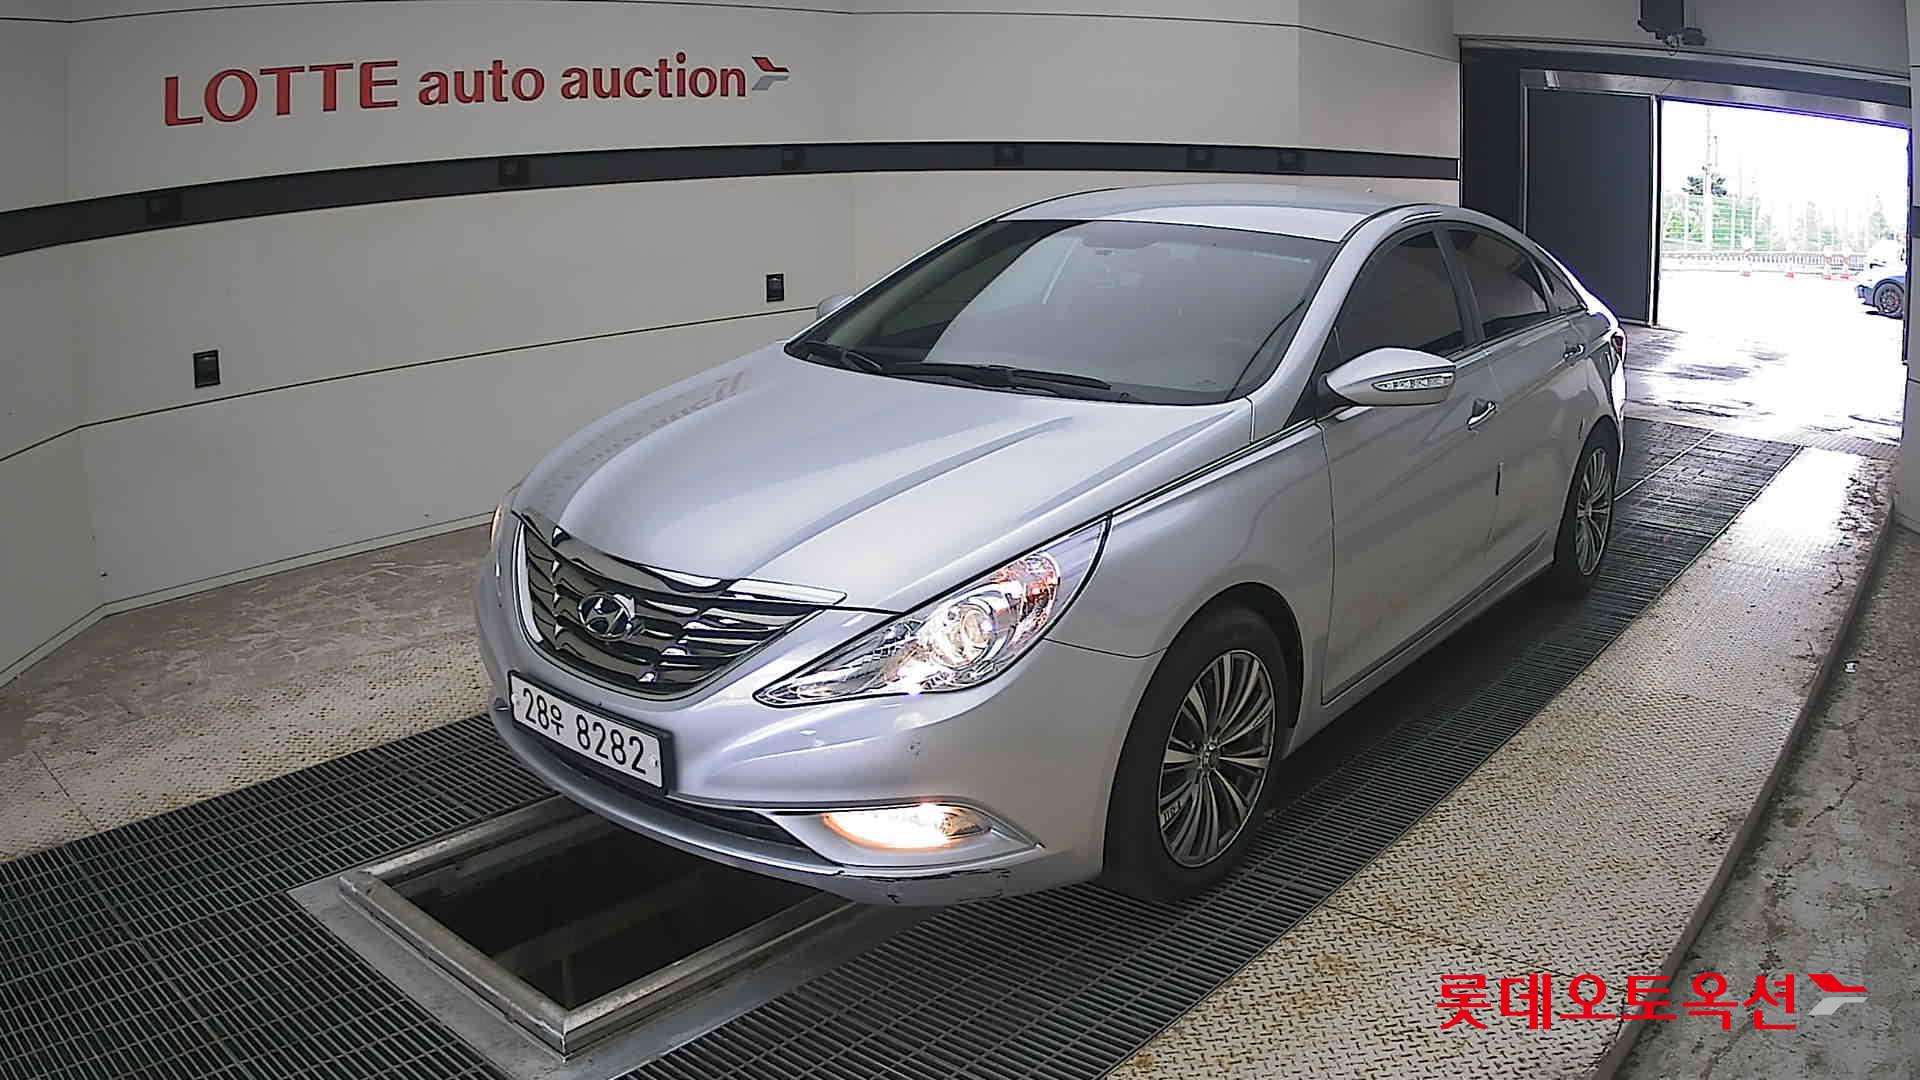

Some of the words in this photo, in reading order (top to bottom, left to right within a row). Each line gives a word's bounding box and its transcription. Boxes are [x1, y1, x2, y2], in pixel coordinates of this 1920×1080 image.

[164, 60, 398, 126] LOTTE
[417, 59, 546, 105] auto
[560, 52, 747, 99] auction
[523, 687, 565, 736] 28우
[575, 714, 647, 775] 8282
